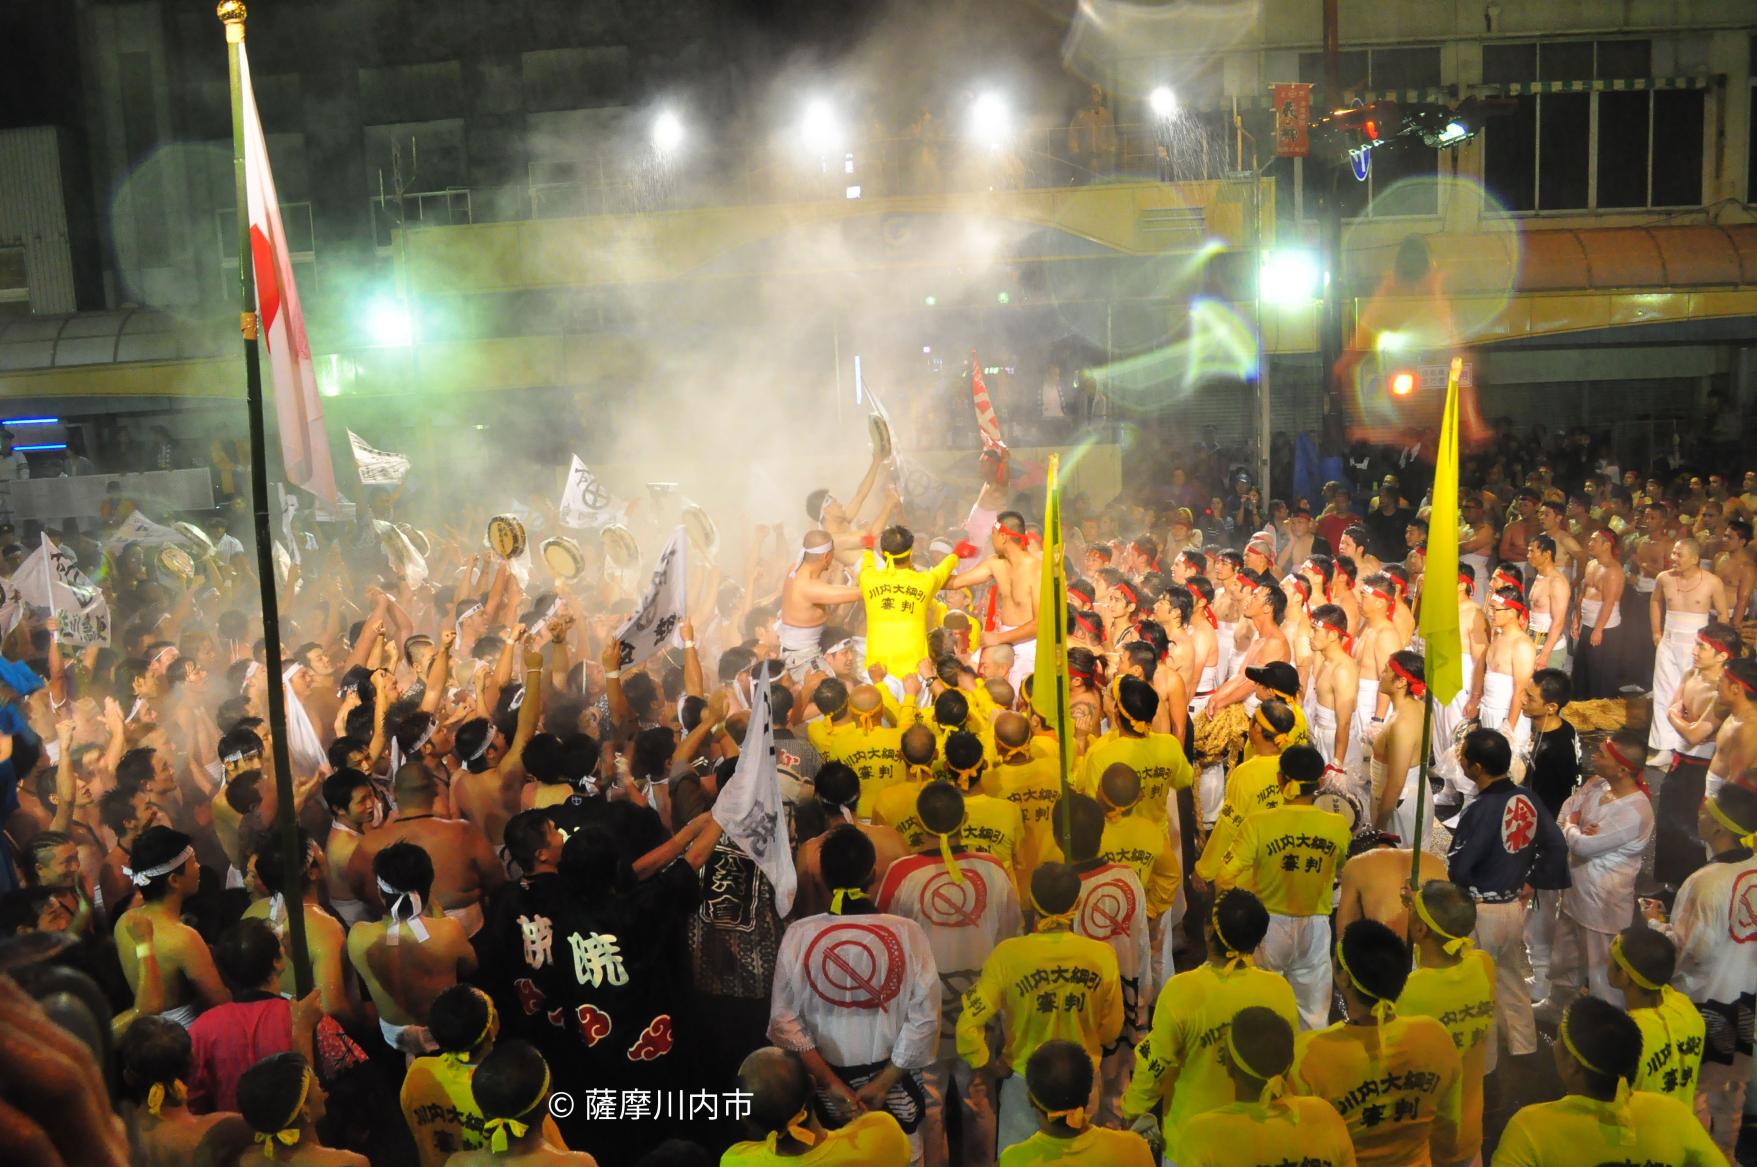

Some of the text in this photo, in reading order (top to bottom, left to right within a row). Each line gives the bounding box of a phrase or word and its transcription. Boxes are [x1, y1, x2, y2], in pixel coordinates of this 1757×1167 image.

[868, 584, 926, 603] 川内大綱引
[880, 597, 915, 614] 審判
[858, 763, 894, 780] 審判
[1265, 832, 1337, 858] 川内大綱引
[1280, 853, 1323, 873] 審判
[1015, 965, 1102, 998] 川内大綱引
[1036, 991, 1086, 1014] 審判
[1338, 1069, 1441, 1116] 川内大綱引
[1360, 1097, 1421, 1128] 審判
